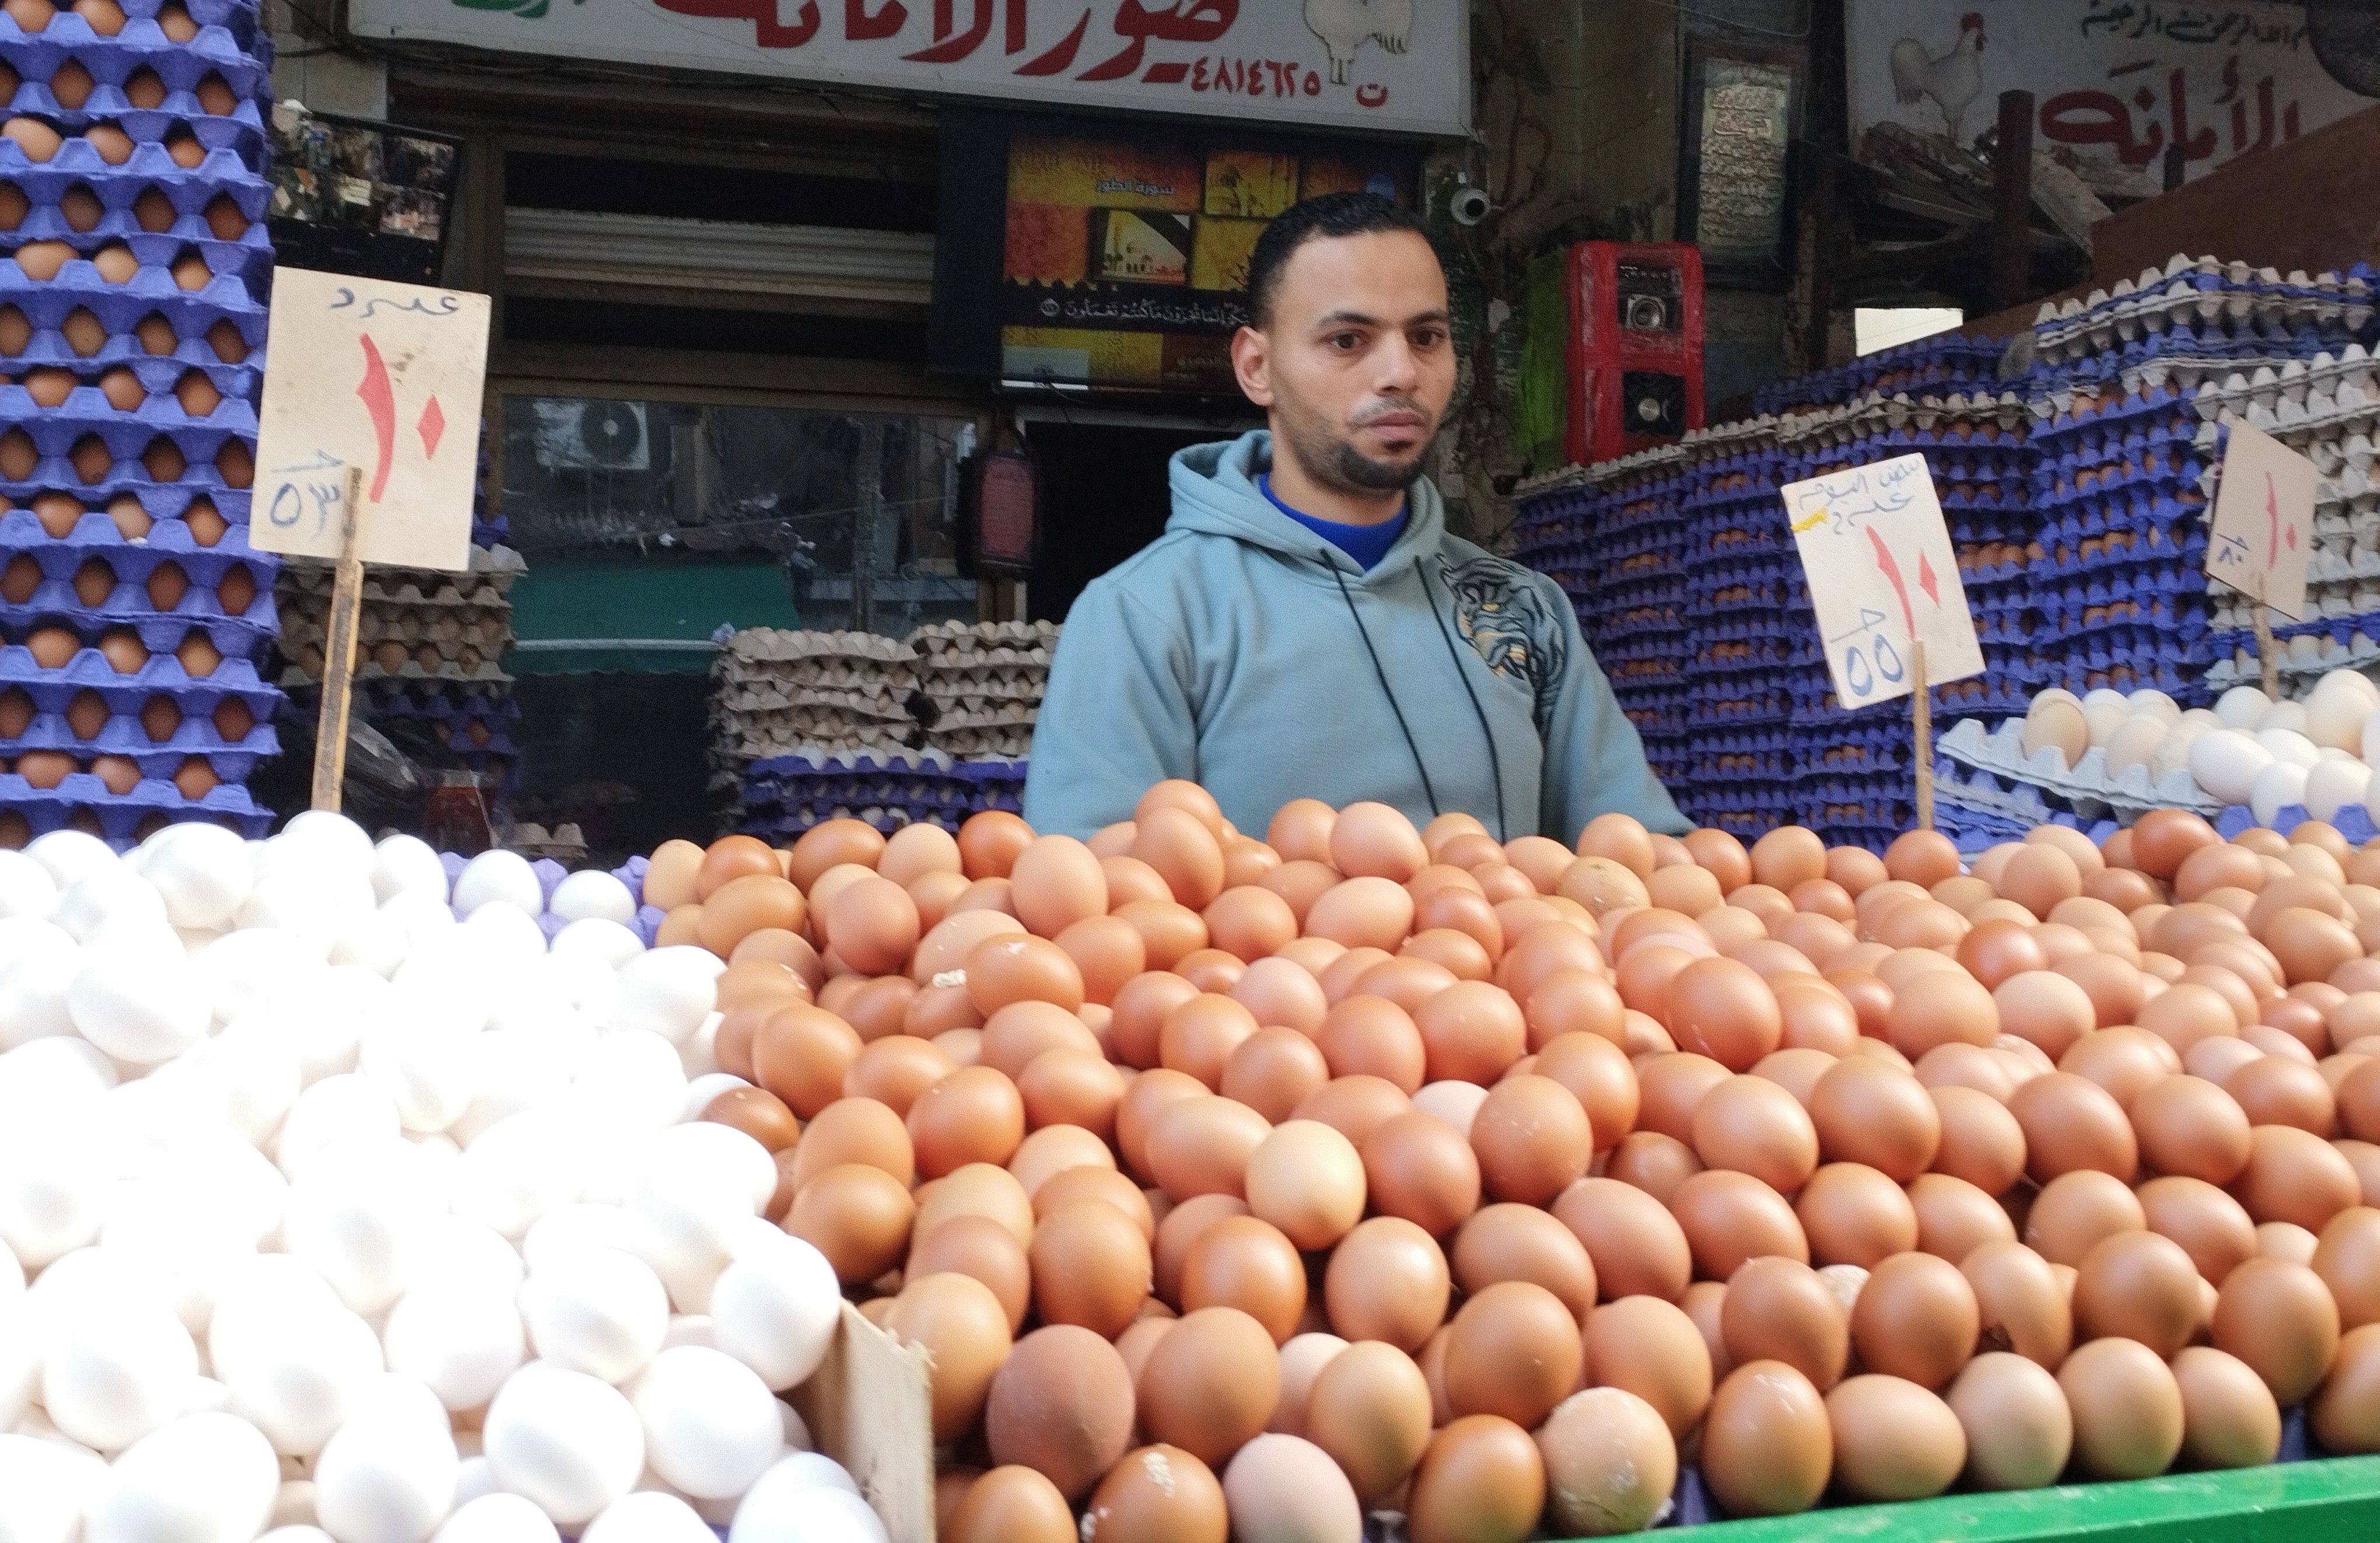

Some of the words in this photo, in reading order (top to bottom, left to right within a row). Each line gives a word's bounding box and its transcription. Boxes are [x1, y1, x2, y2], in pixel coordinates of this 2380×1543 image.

[1191, 57, 1321, 97] ٤٨١٤٦٢٥
[269, 481, 341, 541] ٥٣
[1846, 633, 1904, 697] ٥٥
